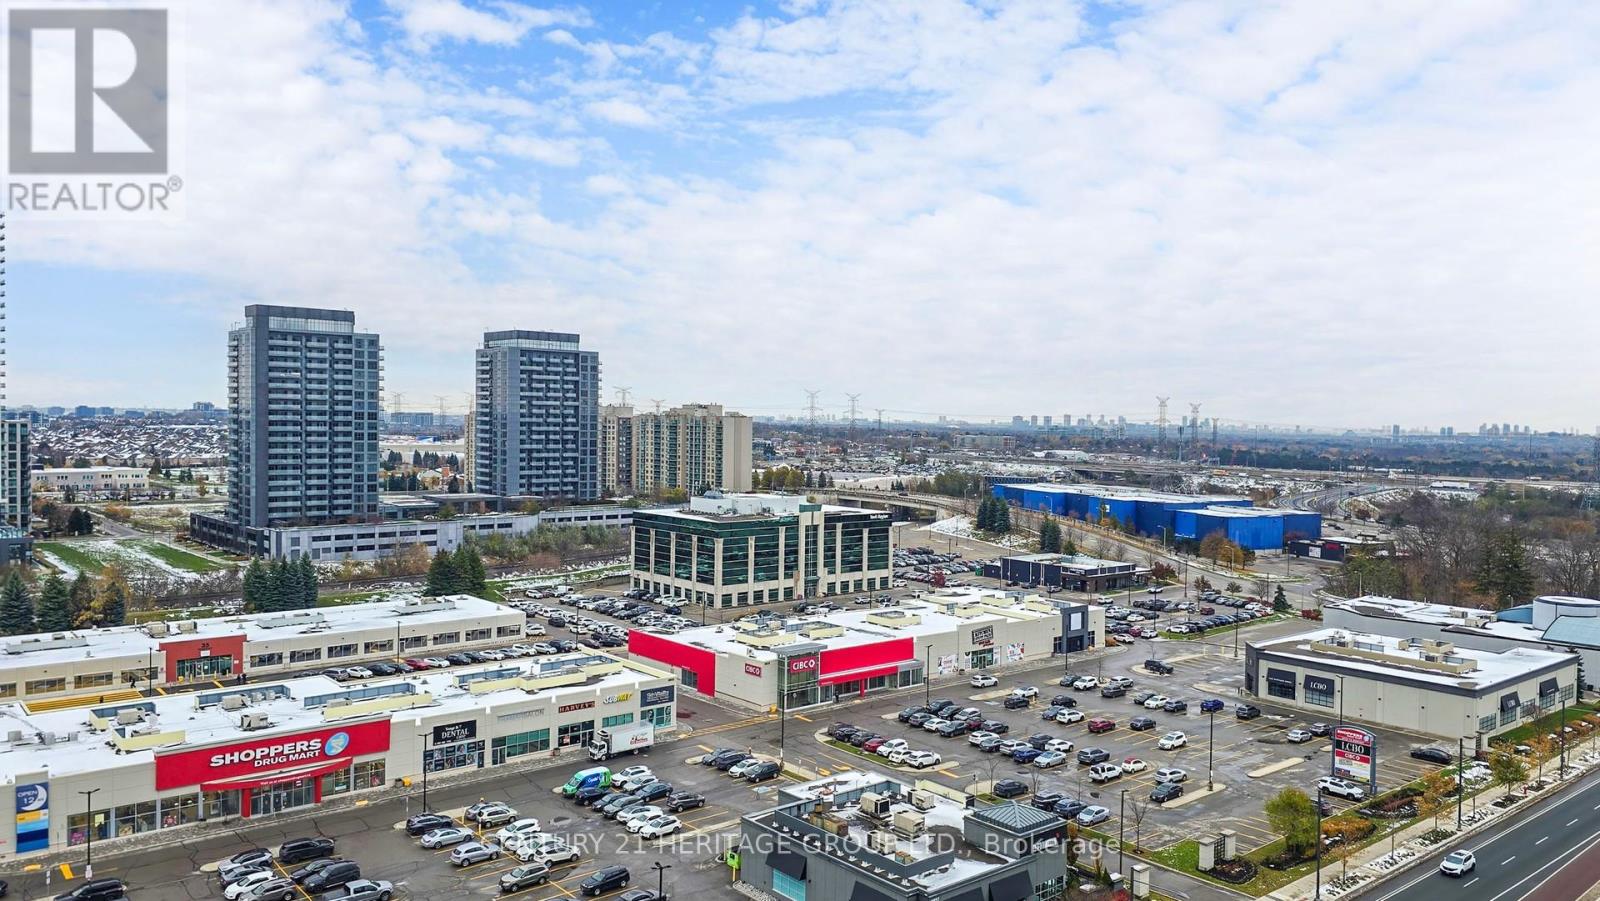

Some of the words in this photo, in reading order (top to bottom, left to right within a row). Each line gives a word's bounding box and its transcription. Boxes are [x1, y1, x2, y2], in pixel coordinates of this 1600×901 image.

[745, 665, 757, 674] CIBC
[793, 660, 809, 671] CIBC
[1310, 681, 1327, 690] LCBO
[603, 691, 633, 704] SUBWAY
[559, 701, 595, 713] HARVEY'S
[441, 728, 470, 739] DENTAL
[209, 738, 322, 768] SHOPPERS
[1341, 741, 1365, 754] LCBO
[254, 755, 288, 768] DRUG
[288, 749, 321, 762] MART
[17, 790, 38, 798] OPEN
